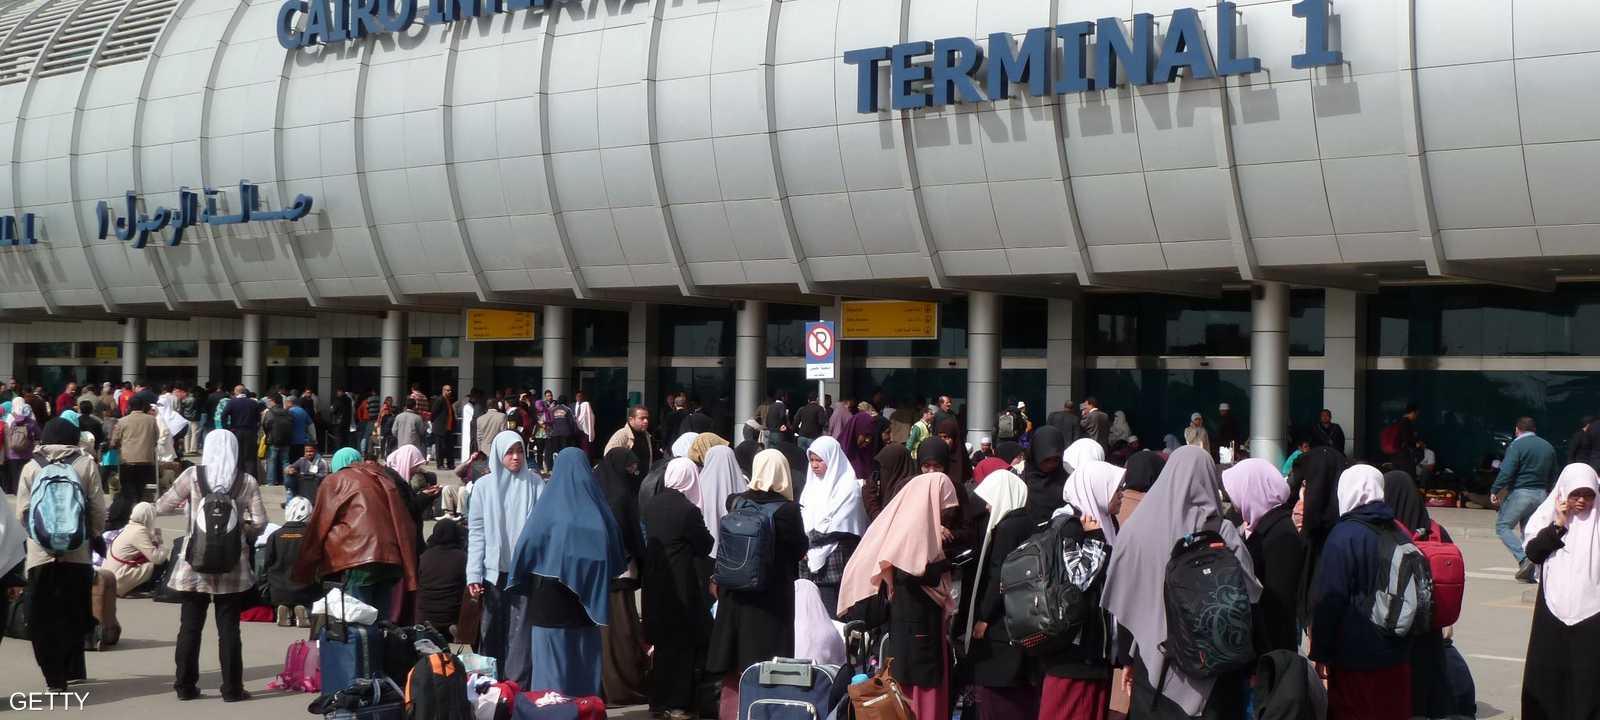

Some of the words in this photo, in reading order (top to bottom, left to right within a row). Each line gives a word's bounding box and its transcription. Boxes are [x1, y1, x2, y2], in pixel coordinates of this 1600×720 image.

[277, 0, 417, 49] CAIRO
[844, 1, 1261, 114] TERMINAL
[1291, 0, 1343, 69] 1
[115, 186, 199, 248] الوصول
[201, 179, 313, 226] صالة
